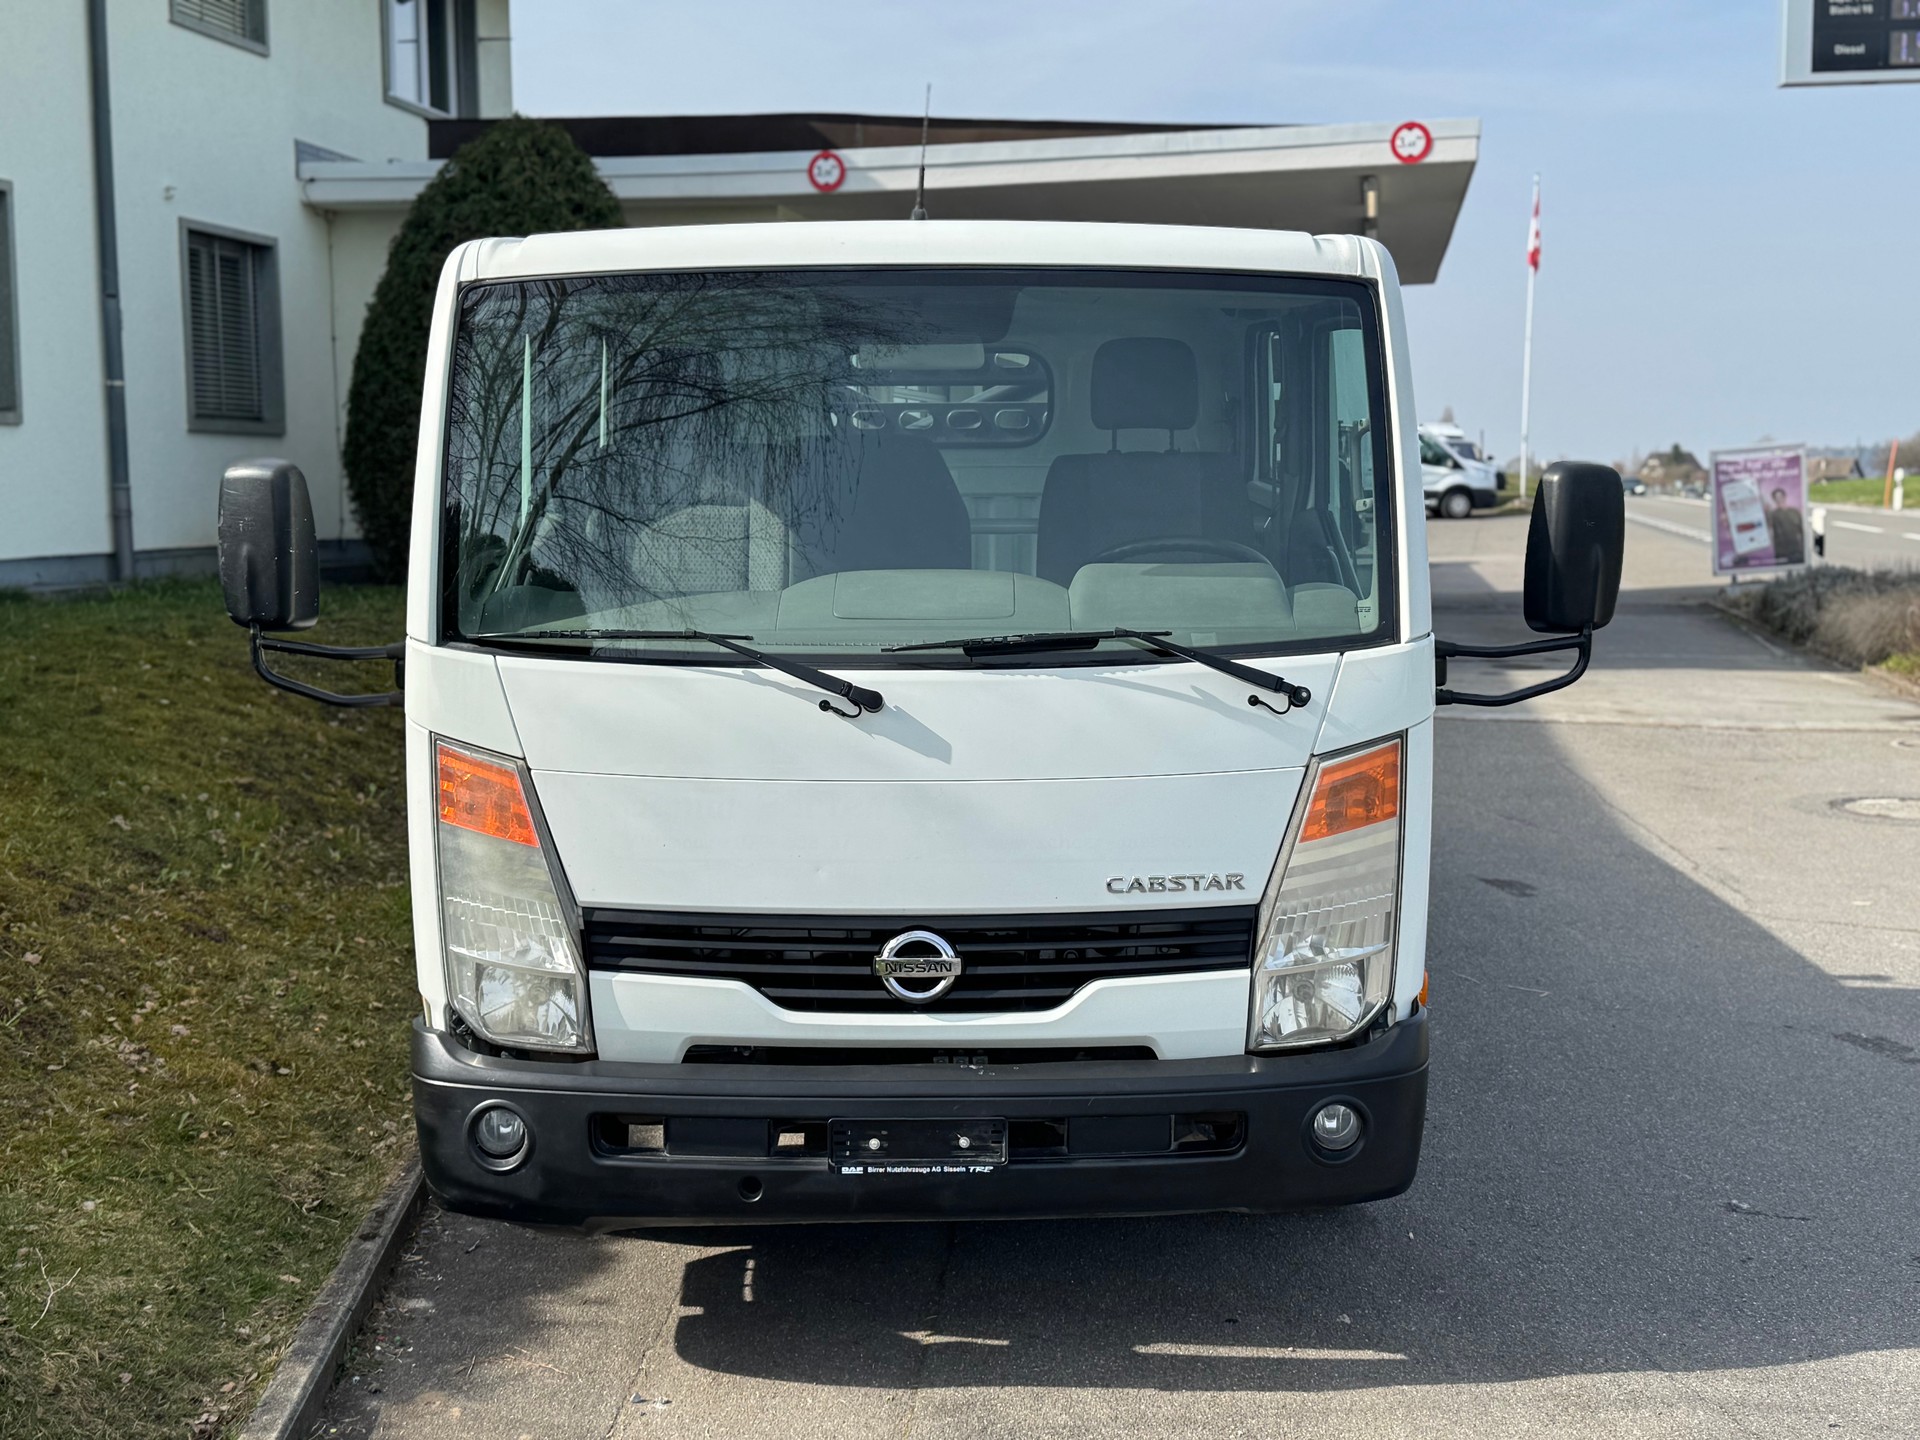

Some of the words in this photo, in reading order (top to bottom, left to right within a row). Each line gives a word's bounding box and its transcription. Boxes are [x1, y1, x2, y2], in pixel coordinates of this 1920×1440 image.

[1833, 43, 1866, 56] Diesel
[1106, 873, 1245, 894] CABSTAR
[885, 962, 953, 974] NISSAN
[887, 1165, 930, 1174] Nutzfahrzeuge
[931, 1165, 941, 1173] AG
